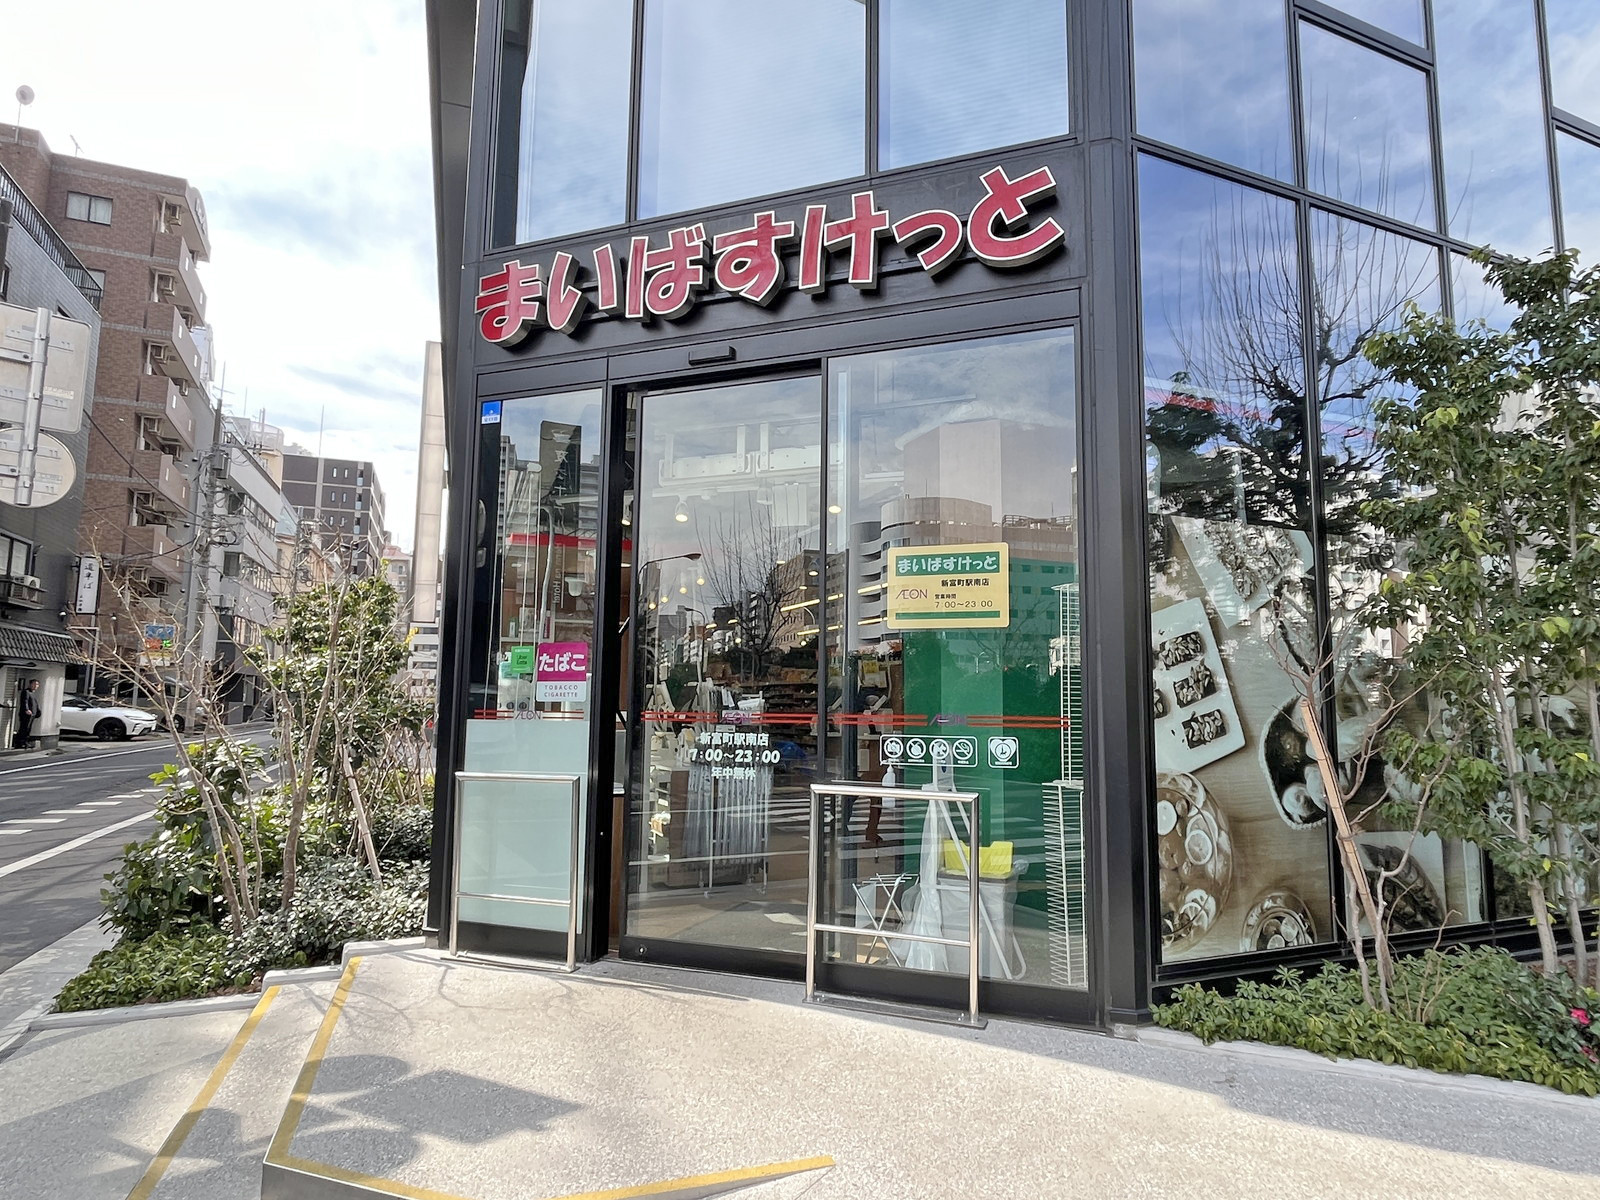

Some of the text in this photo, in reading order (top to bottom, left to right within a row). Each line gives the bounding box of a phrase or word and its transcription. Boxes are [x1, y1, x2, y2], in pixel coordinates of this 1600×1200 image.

[475, 165, 1065, 344] まいばすけっと
[898, 556, 997, 573] まいばすけっと
[941, 578, 990, 588] 新富町駅南店
[539, 652, 585, 672] たばこ
[700, 732, 770, 747] 新富町駅南店
[711, 767, 757, 780] 年中無休
